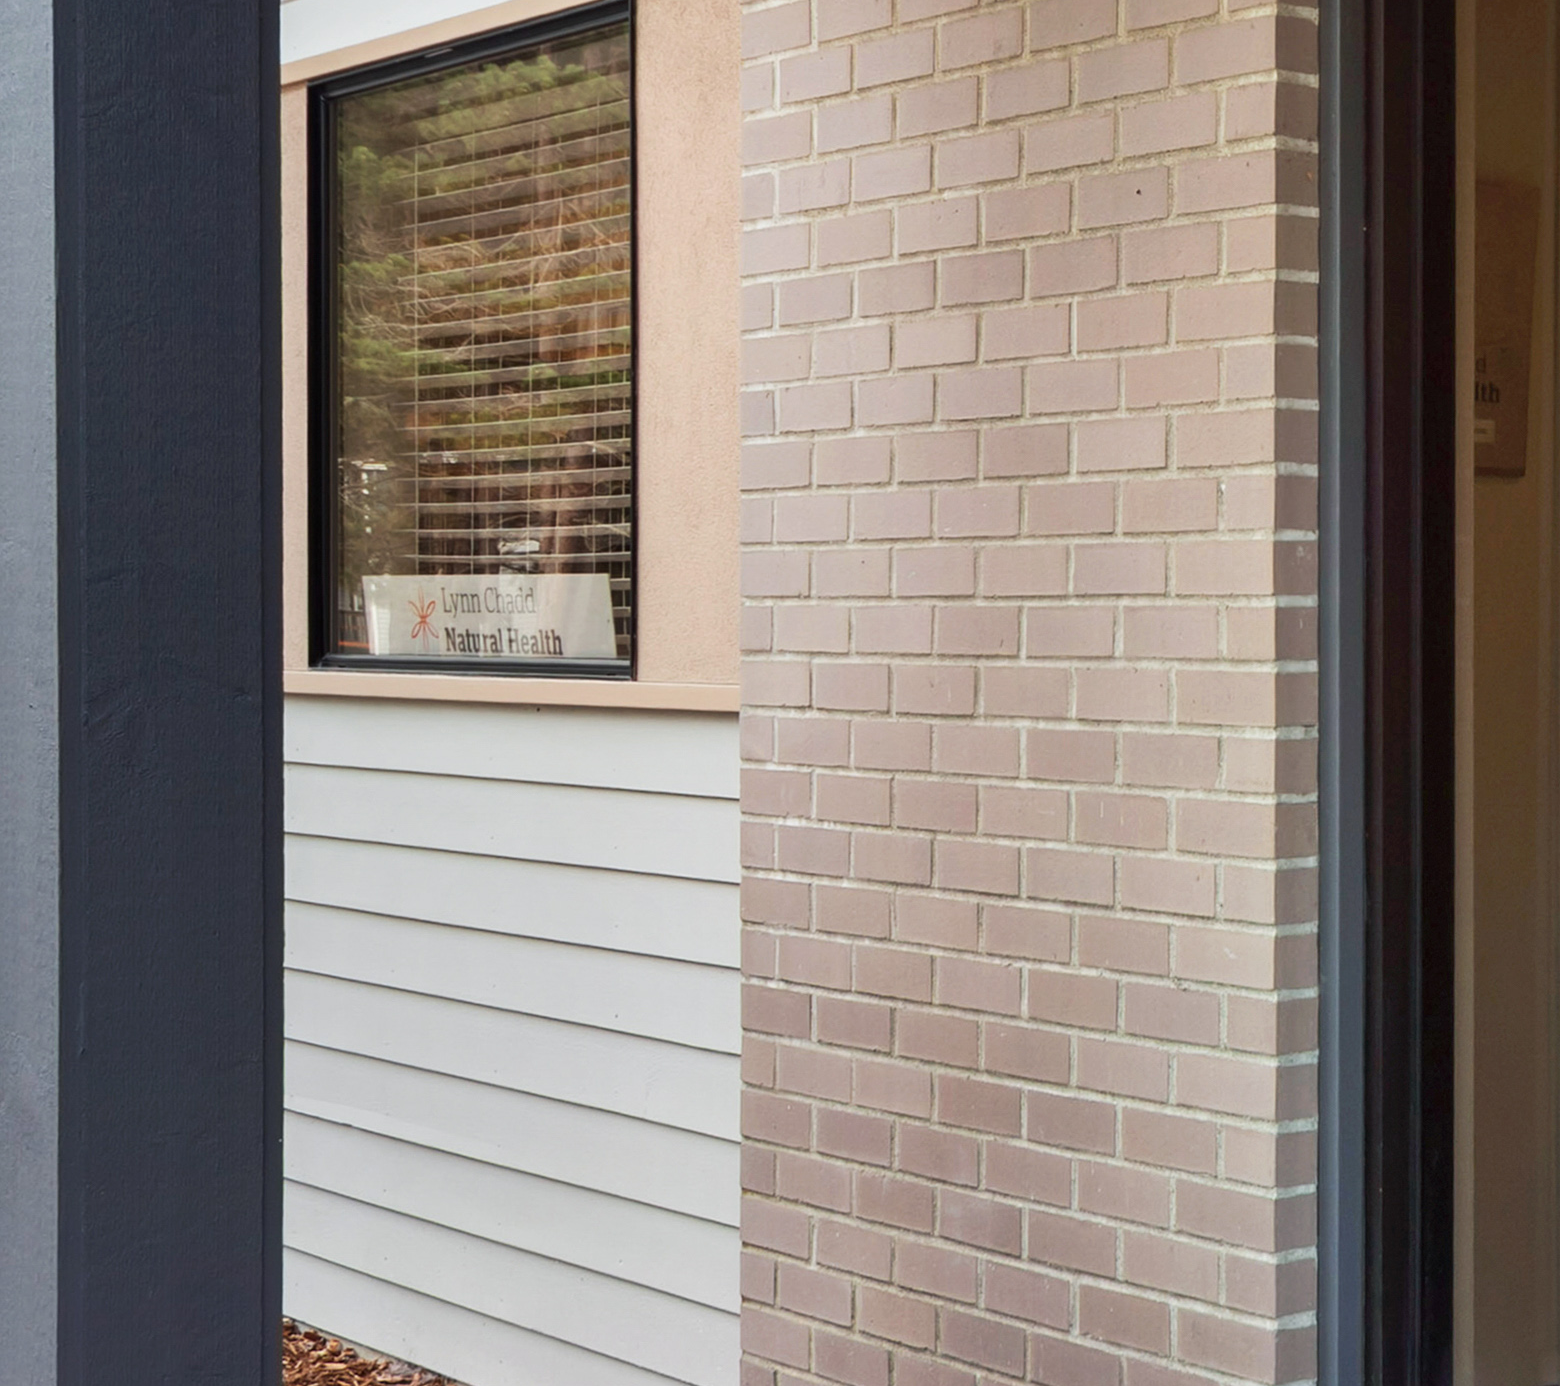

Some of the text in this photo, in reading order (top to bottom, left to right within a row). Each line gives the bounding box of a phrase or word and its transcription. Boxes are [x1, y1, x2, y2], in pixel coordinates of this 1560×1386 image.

[441, 587, 536, 619] Lynn Chadd
[444, 627, 564, 656] Natural Health
